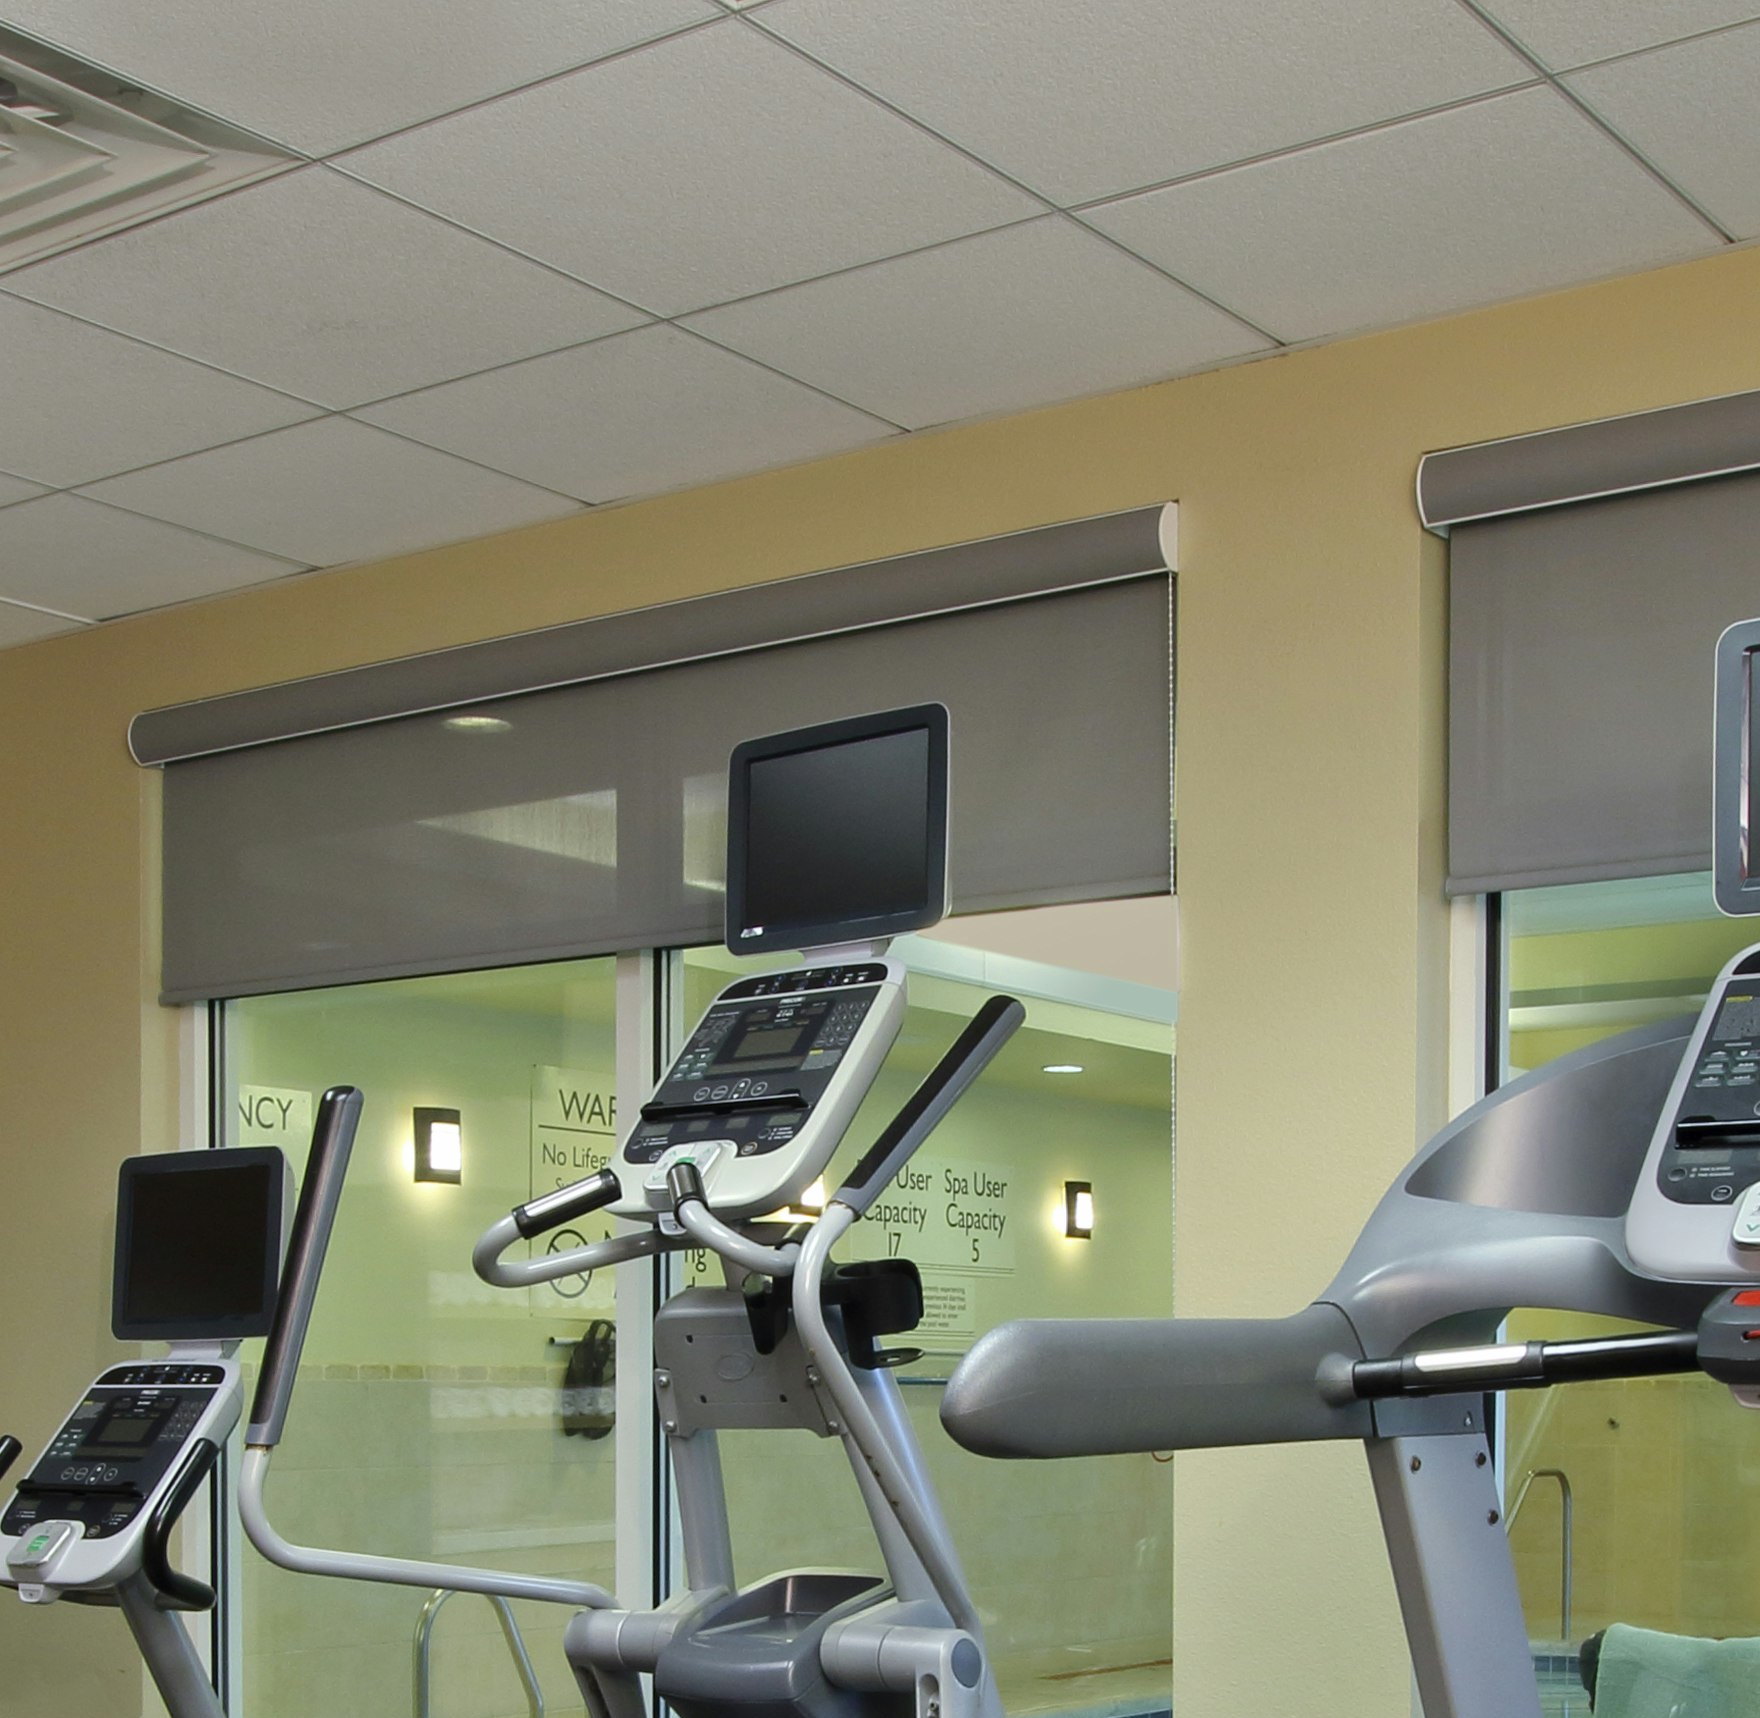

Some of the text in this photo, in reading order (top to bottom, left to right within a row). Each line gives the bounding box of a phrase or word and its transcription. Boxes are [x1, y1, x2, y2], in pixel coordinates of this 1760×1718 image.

[542, 1143, 567, 1167] No
[896, 1164, 932, 1191] User
[944, 1168, 1007, 1200] Spa User
[864, 1201, 927, 1232] Capacity
[946, 1203, 1006, 1239] Capacity
[888, 1232, 902, 1257] 17
[971, 1238, 980, 1262] 5
